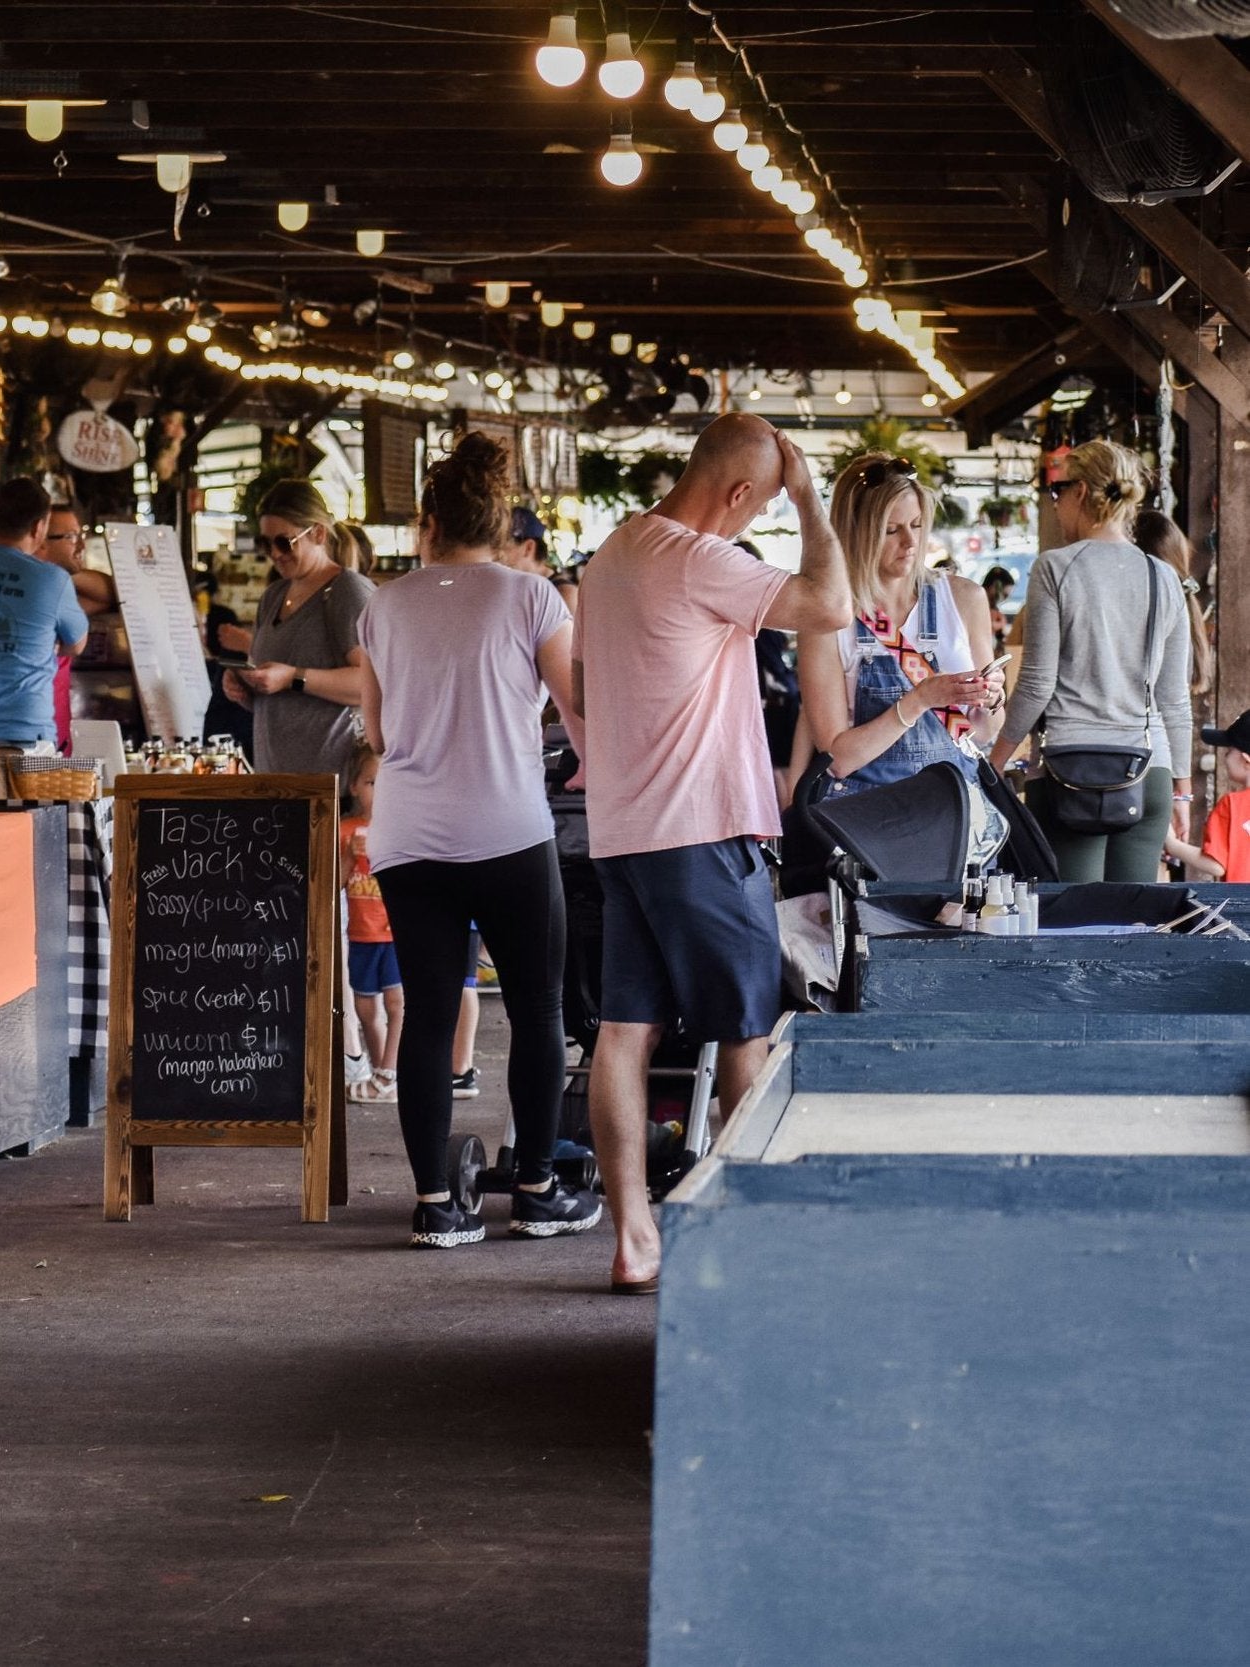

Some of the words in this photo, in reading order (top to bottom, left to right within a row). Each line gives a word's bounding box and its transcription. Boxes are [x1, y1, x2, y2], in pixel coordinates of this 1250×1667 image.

[144, 808, 239, 845] Taste
[253, 805, 285, 846] of
[171, 841, 273, 882] Jack's
[254, 896, 288, 922] $11
[194, 983, 254, 1012] (verde)
[257, 985, 290, 1013] $11
[143, 1030, 231, 1052] unicorn
